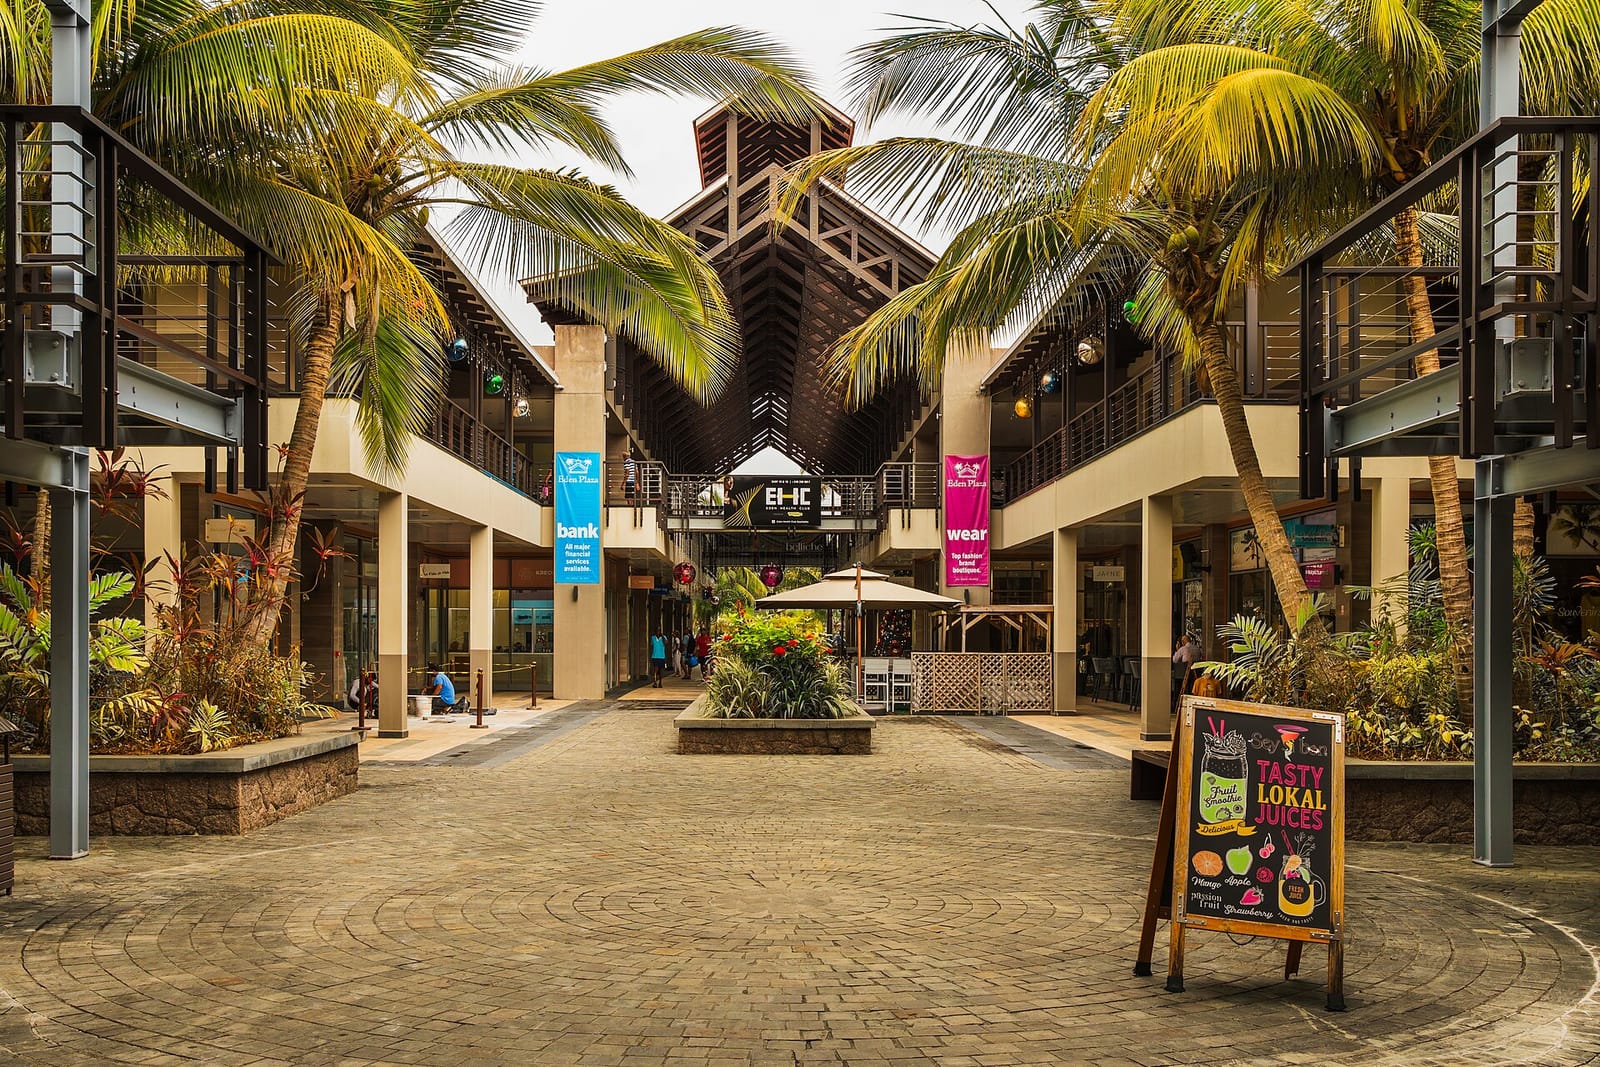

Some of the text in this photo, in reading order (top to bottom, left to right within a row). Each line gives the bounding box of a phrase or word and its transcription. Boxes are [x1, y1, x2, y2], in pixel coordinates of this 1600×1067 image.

[558, 475, 599, 483] Eden Plaza
[765, 487, 811, 506] EHC
[557, 522, 599, 538] bank
[947, 528, 987, 541] wear
[565, 543, 591, 552] All major
[952, 567, 981, 575] boutiques.
[1257, 759, 1324, 789] TASTY
[1210, 783, 1238, 799] Fruit
[1257, 783, 1327, 810] LOKAL
[1204, 795, 1242, 808] Smoothie
[1254, 804, 1324, 831] JUICES
[1200, 824, 1236, 835] Delicious
[1191, 876, 1222, 890] Mango
[1224, 875, 1252, 887] Apple
[1288, 884, 1305, 893] FRESH
[1191, 892, 1222, 902] passion
[1288, 892, 1303, 900] JUICE
[1223, 904, 1274, 919] Strawberry
